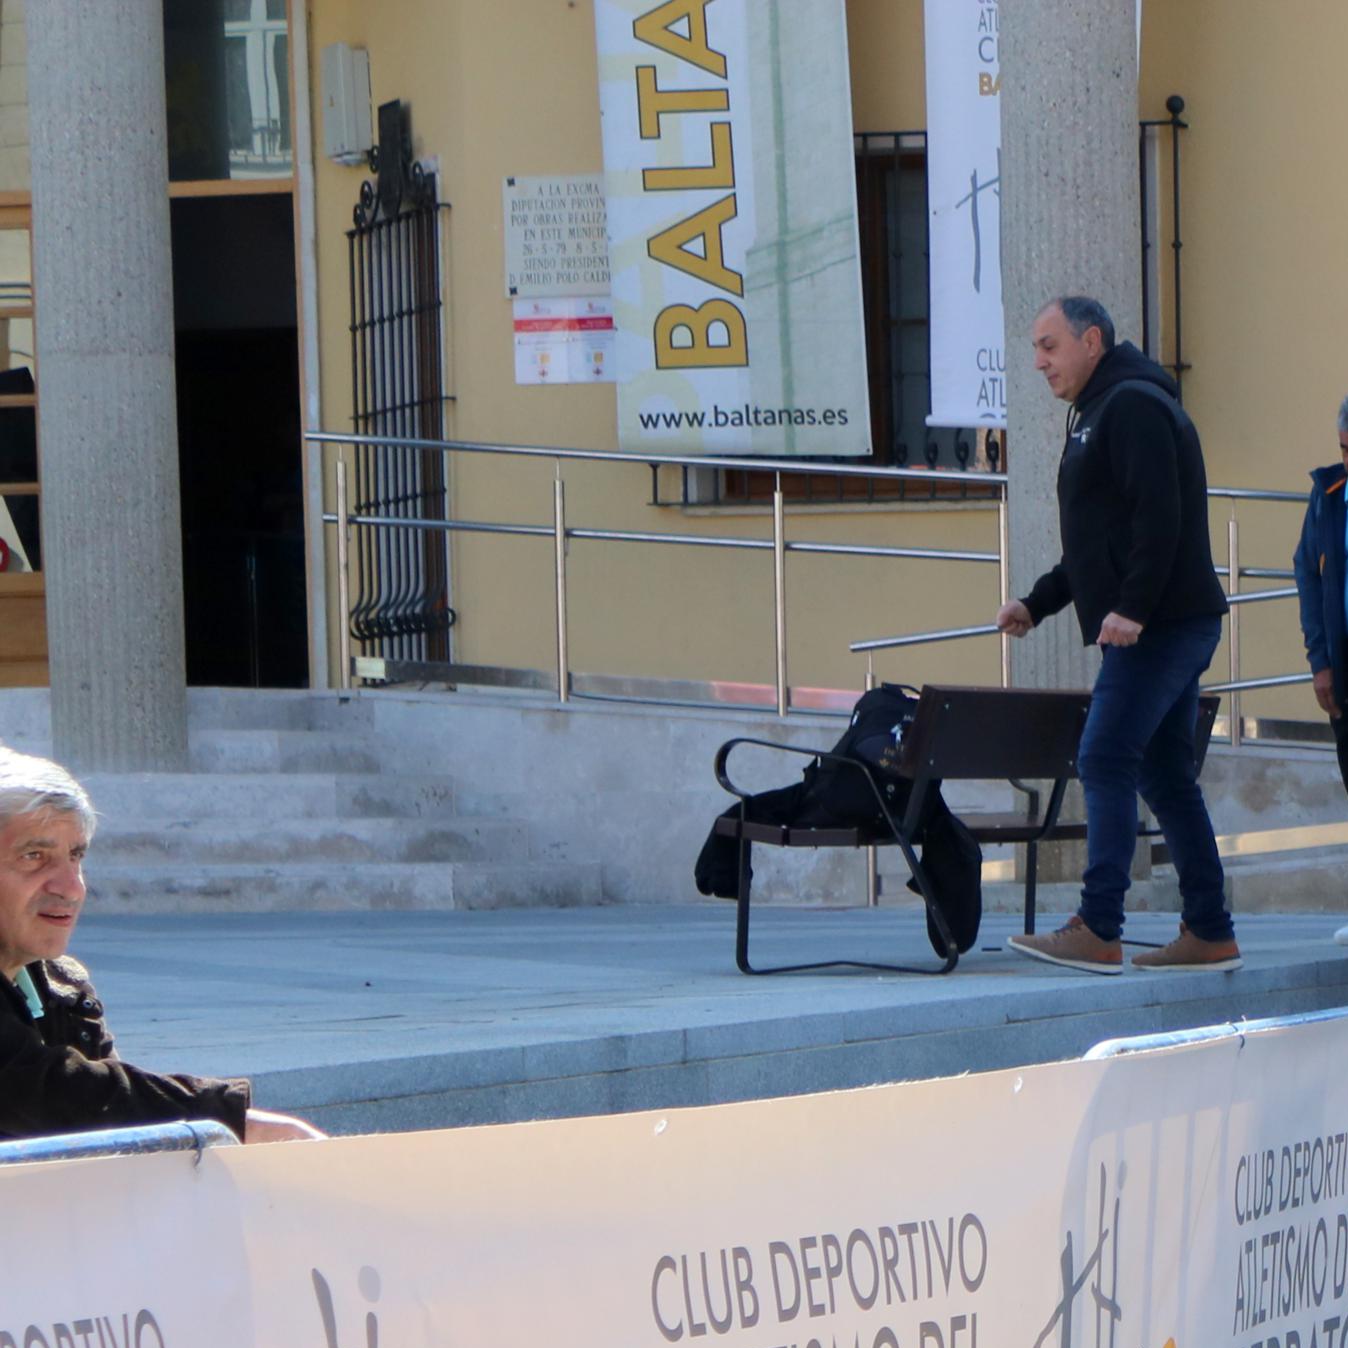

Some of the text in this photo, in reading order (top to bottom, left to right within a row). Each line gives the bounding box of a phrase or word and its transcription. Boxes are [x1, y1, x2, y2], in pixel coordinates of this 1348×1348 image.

[639, 404, 848, 430] www.baltanas.es
[1234, 1160, 1276, 1226] CLUB
[651, 1212, 988, 1342] CLUB DEPORTIVO
[1233, 1216, 1328, 1336] ATLETISMO
